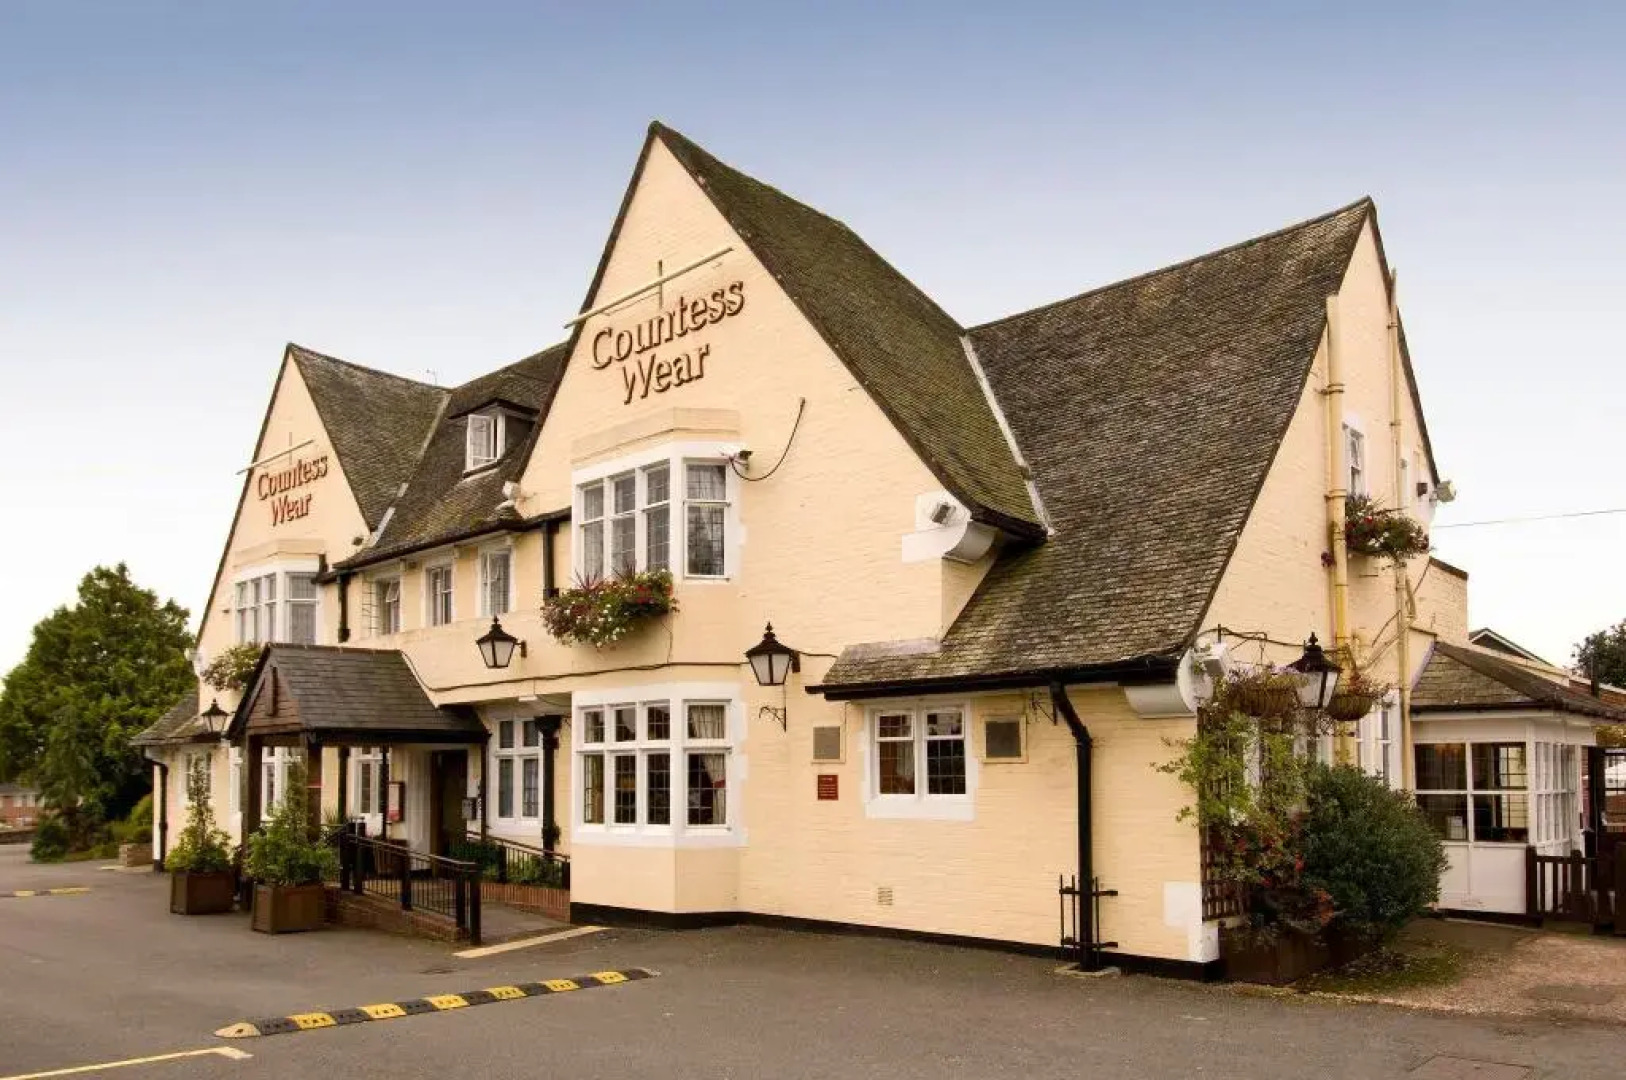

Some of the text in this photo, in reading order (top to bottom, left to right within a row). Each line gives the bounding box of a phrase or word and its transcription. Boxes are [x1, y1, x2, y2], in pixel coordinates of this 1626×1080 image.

[592, 281, 745, 370] Countess
[622, 343, 710, 405] Wear
[258, 455, 328, 500] Countess
[271, 493, 312, 527] Wear
